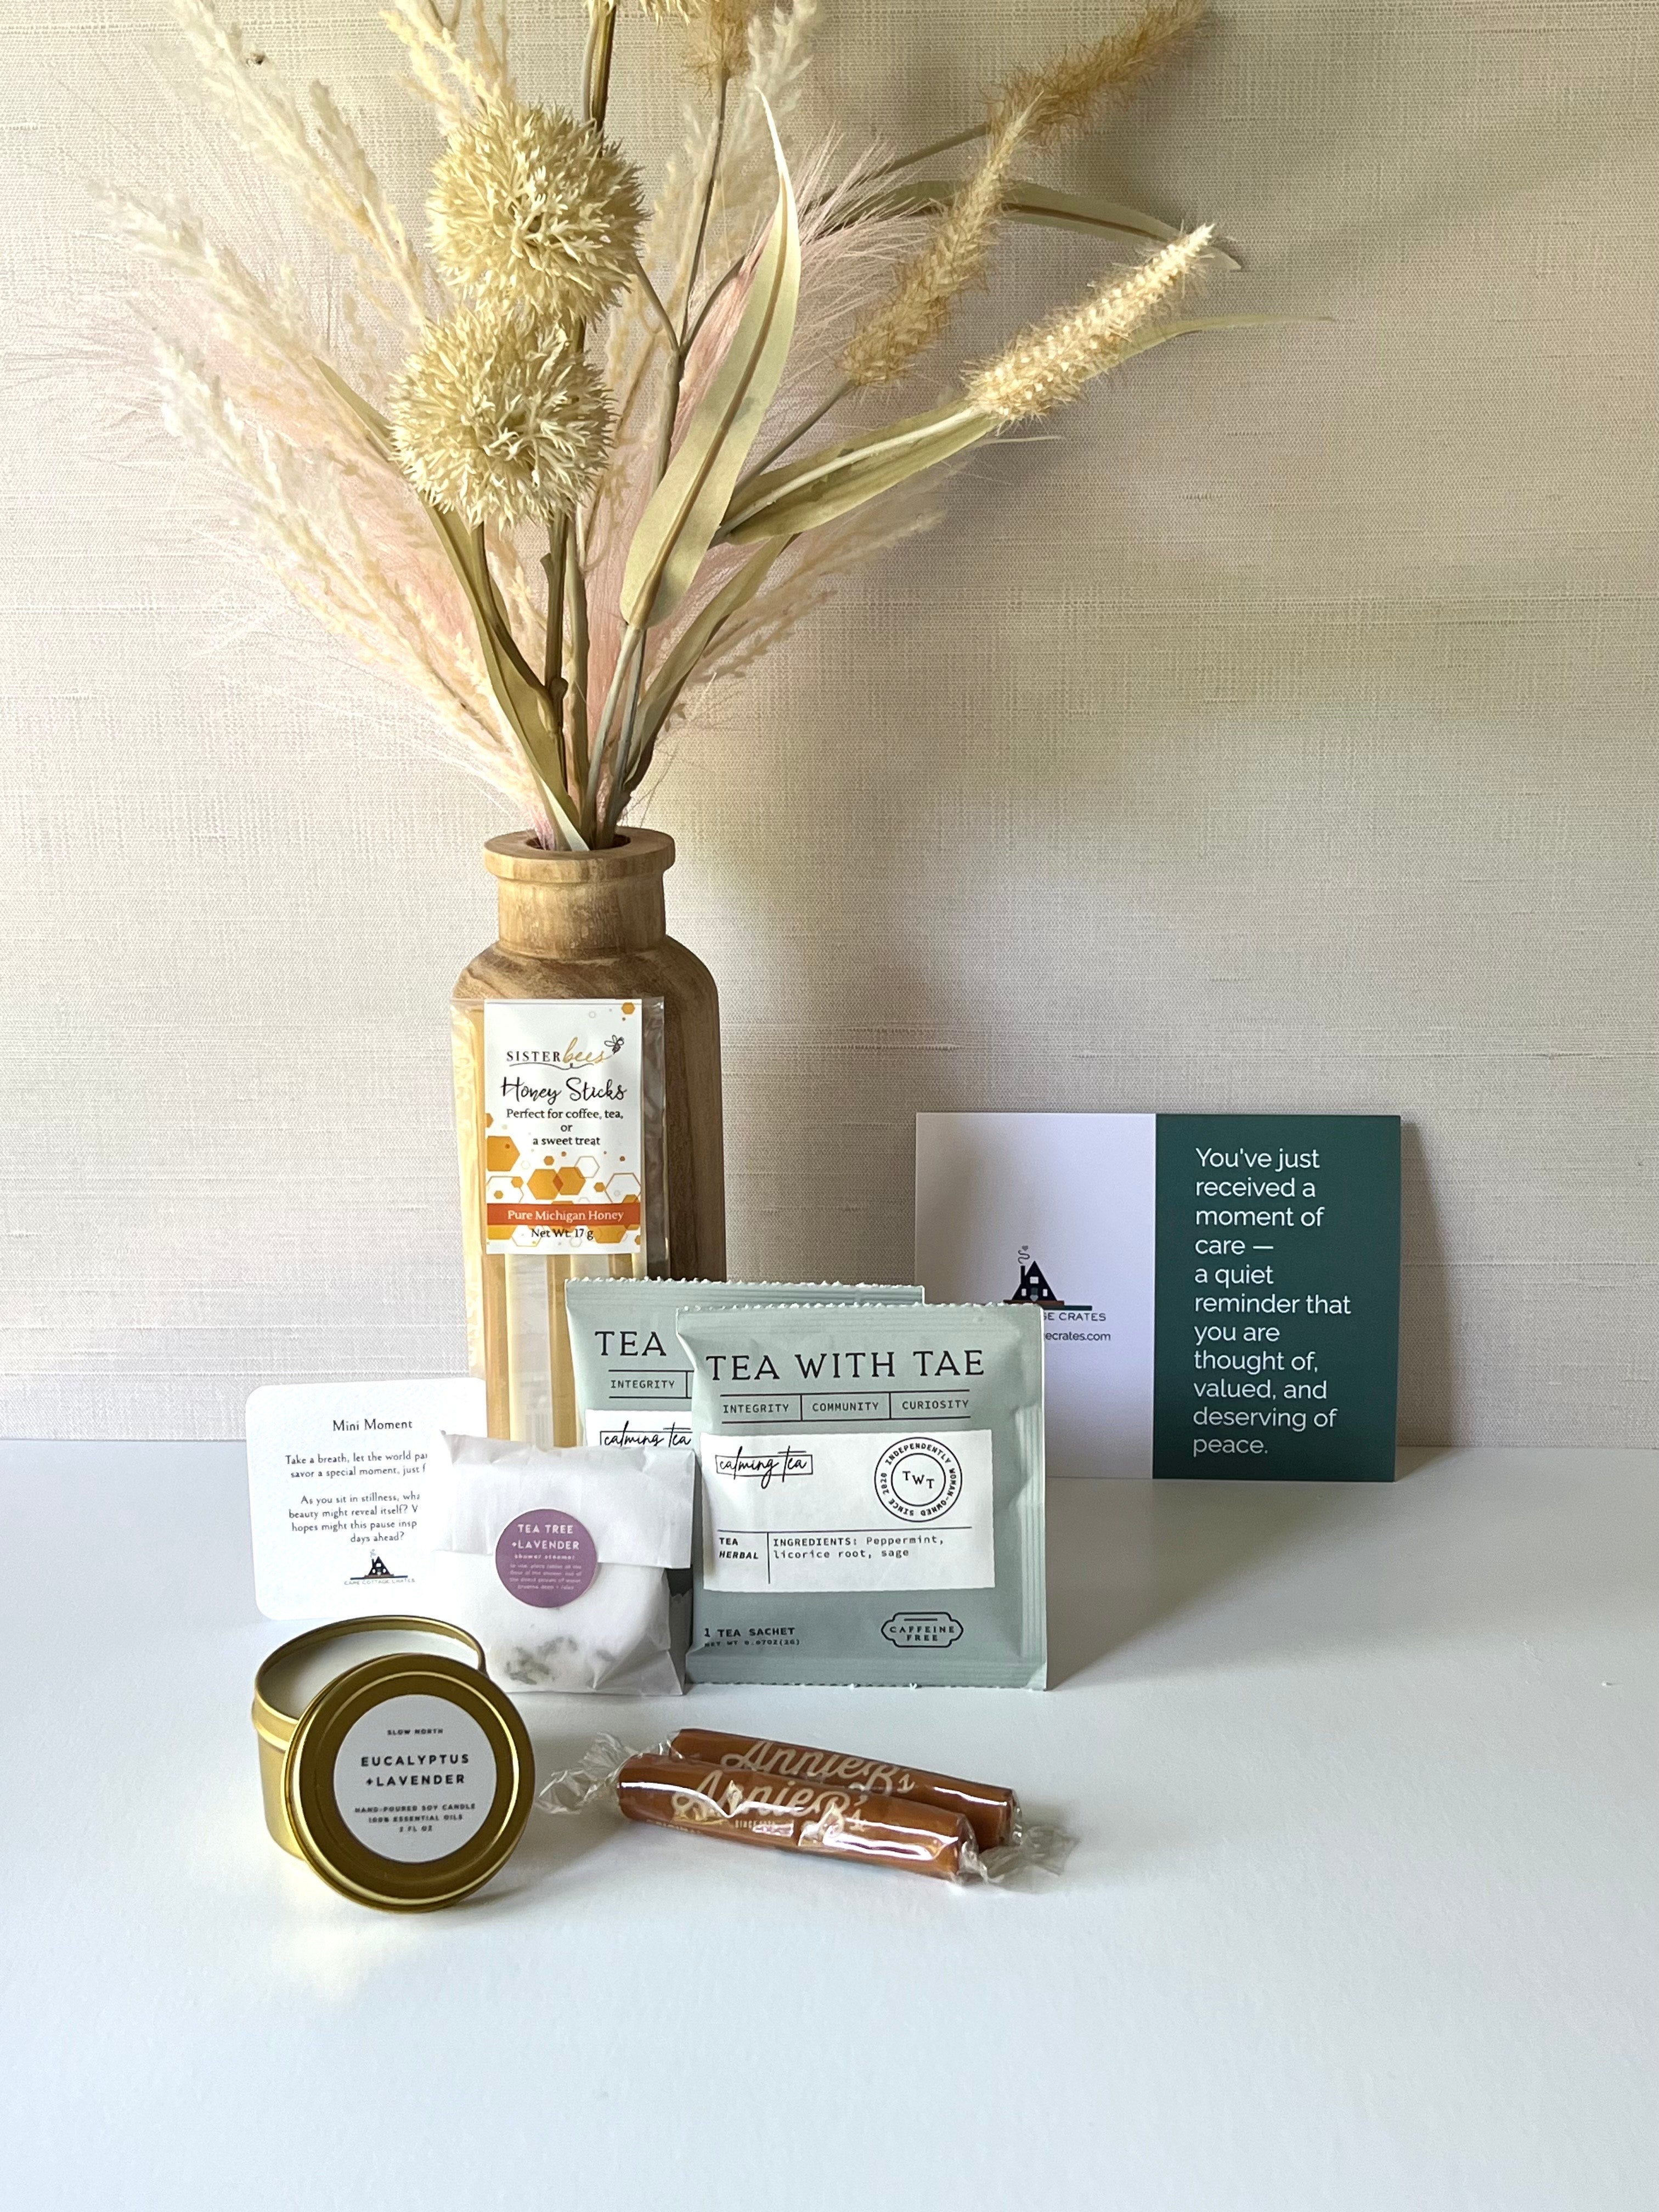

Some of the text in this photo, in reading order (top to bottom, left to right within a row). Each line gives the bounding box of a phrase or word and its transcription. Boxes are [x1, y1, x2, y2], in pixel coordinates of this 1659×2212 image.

[500, 1076, 628, 1105] Honey Sticks
[506, 1108, 624, 1120] Perfect for coffee, tea,
[541, 1137, 572, 1145] sweet
[575, 1137, 601, 1146] treat
[1195, 1148, 1320, 1172] You've just
[1196, 1177, 1316, 1197] received a
[507, 1210, 624, 1223] Pure Michigan Honey
[1196, 1206, 1325, 1227] moment of
[531, 1228, 550, 1238] Net
[575, 1228, 584, 1238] 17
[586, 1231, 594, 1240] g
[1195, 1239, 1245, 1255] care
[1194, 1264, 1274, 1289] a quiet
[1195, 1293, 1351, 1314] reminder that
[1059, 1312, 1107, 1322] CRATES
[1194, 1325, 1280, 1346] you are
[595, 1331, 667, 1356] TEA
[706, 1350, 985, 1381] TEA WITH TAE
[1194, 1350, 1318, 1375] thought of,
[611, 1380, 675, 1389] INTEGRITY
[1193, 1378, 1327, 1400] valued, and
[723, 1404, 789, 1413] INTEGRITY
[812, 1402, 879, 1412] COMMUNITY
[902, 1400, 969, 1410] CURIOSITY
[333, 1419, 413, 1431] Mini Moment
[1193, 1406, 1338, 1432] deserving of
[604, 1421, 692, 1447] calming tea
[885, 1443, 951, 1465] INDEPENDENTLY
[1193, 1438, 1268, 1458] peace.
[285, 1454, 306, 1464] Take
[318, 1453, 349, 1463] breath,
[353, 1452, 364, 1462] let
[368, 1451, 382, 1461] the
[385, 1450, 411, 1460] world
[326, 1466, 356, 1479] special
[403, 1466, 420, 1476] just
[719, 1446, 807, 1489] calming tea
[881, 1472, 890, 1494] 2020
[301, 1495, 313, 1504] As
[316, 1498, 332, 1506] you
[361, 1492, 399, 1502] stillness,
[289, 1509, 318, 1520] beauty
[322, 1507, 348, 1519] might
[351, 1505, 377, 1515] reveal
[380, 1504, 408, 1515] itself?
[888, 1498, 914, 1516] SINCE
[292, 1522, 318, 1533] hopes
[321, 1521, 347, 1532] might
[351, 1519, 366, 1529] this
[370, 1522, 395, 1531] pause
[518, 1524, 573, 1534] TEA TREE
[350, 1531, 404, 1544] days ahead?
[719, 1538, 738, 1546] TEA
[774, 1535, 944, 1547] INGREDIENTS: Peppermint,
[719, 1551, 759, 1559] HERBAL
[774, 1549, 909, 1559] licorice root, sage
[704, 1627, 795, 1637] 1 TEA SACHET
[361, 1754, 469, 1767] EUCALYPTUS
